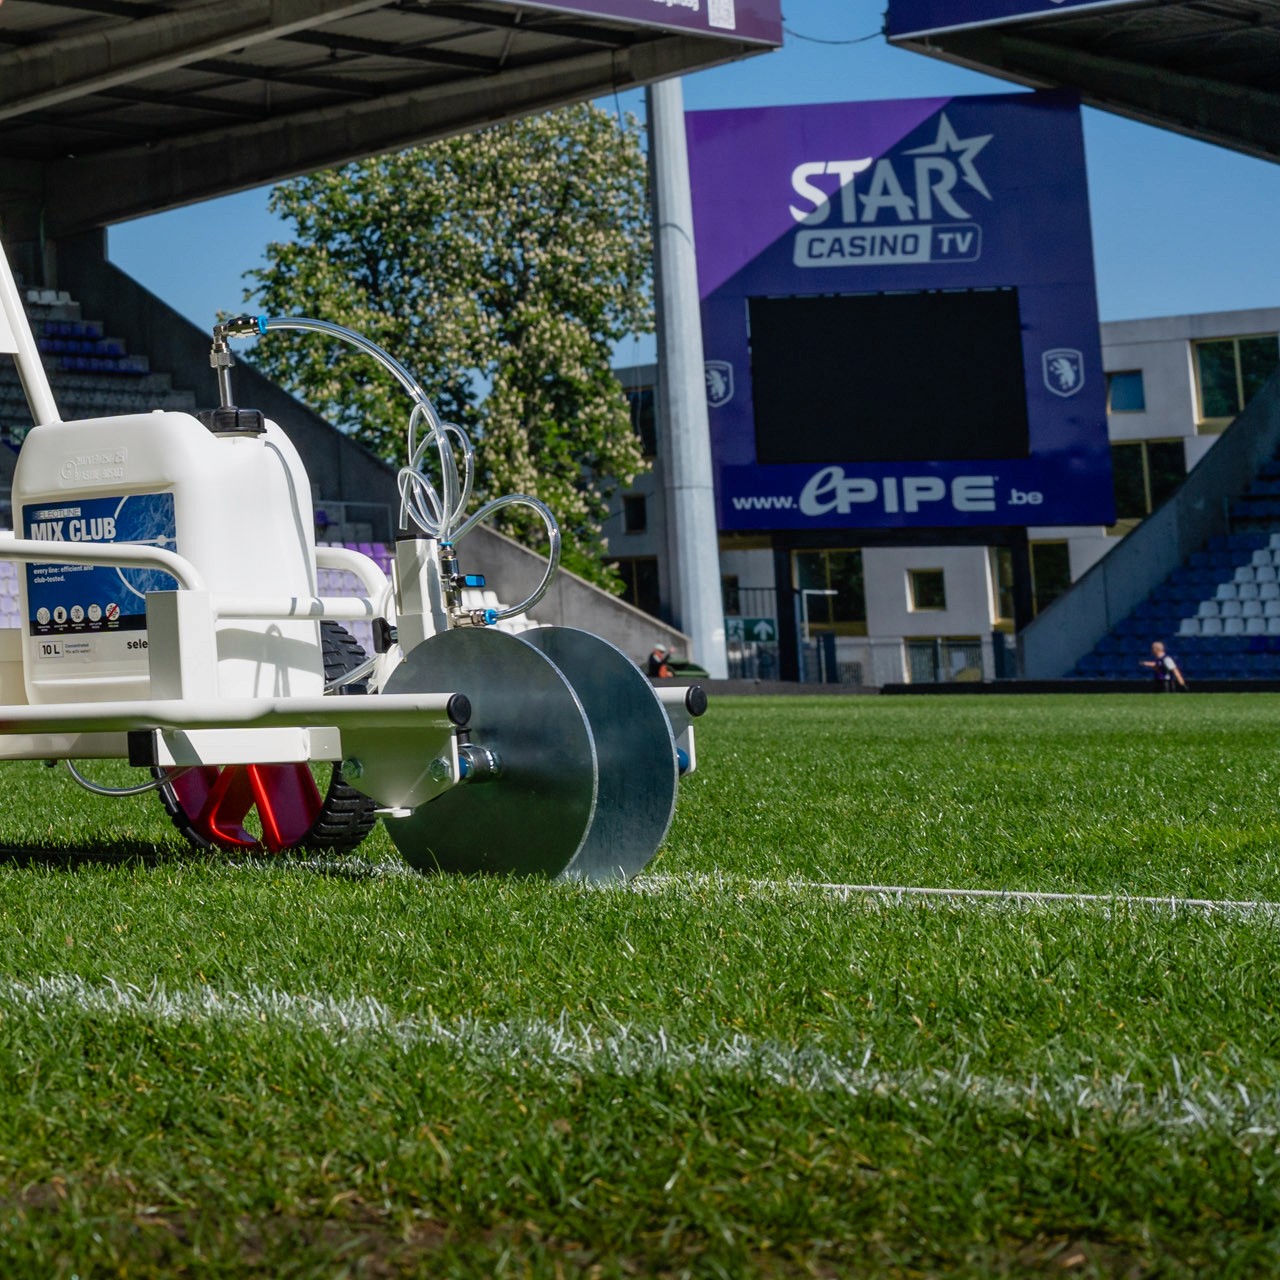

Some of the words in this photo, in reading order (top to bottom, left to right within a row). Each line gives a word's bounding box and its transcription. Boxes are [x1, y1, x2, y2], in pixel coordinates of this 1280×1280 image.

[789, 154, 972, 224] STAR
[806, 232, 920, 260] CASINO
[938, 230, 974, 256] TV
[30, 522, 64, 541] MIX
[68, 517, 117, 542] CLUB
[33, 566, 48, 576] every
[48, 565, 60, 574] line:
[60, 564, 83, 574] efficient
[33, 574, 66, 584] club-tested.
[42, 644, 52, 655] 10
[53, 644, 61, 655] L
